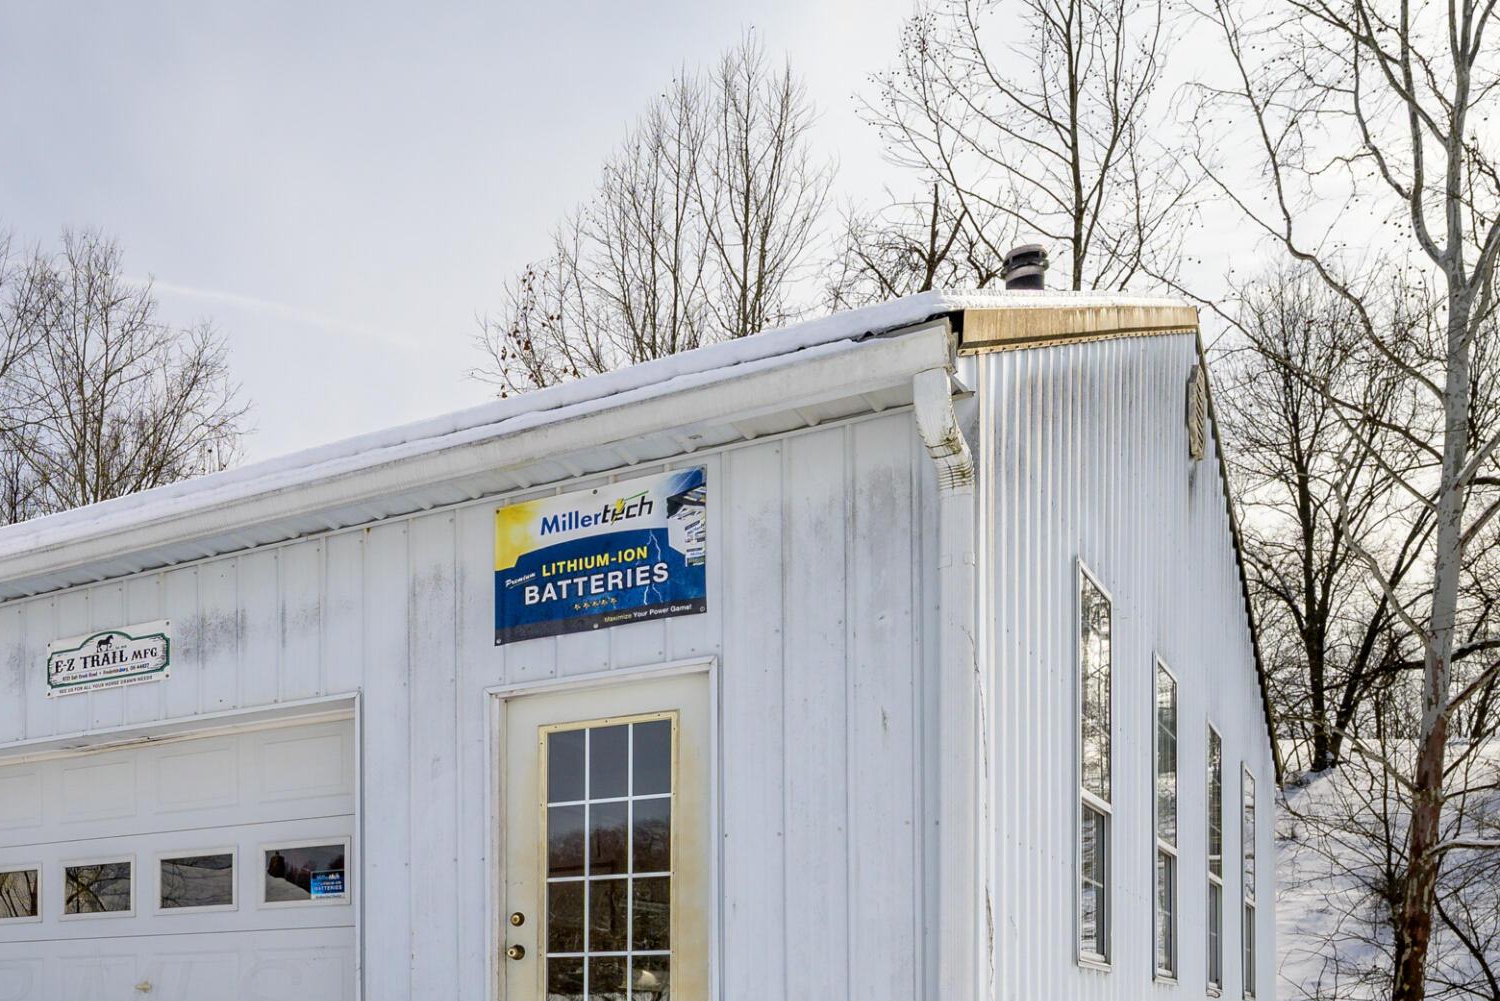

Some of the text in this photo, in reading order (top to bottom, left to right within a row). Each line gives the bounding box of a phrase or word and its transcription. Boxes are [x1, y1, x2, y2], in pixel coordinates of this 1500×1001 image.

[540, 495, 653, 536] Millertech
[541, 546, 648, 577] LITHIUM-ION
[505, 572, 536, 588] Premium
[524, 562, 669, 605] BATTERIES
[633, 610, 648, 618] Your
[649, 607, 669, 616] Power
[55, 647, 157, 674] E-Z TRAIL MFG
